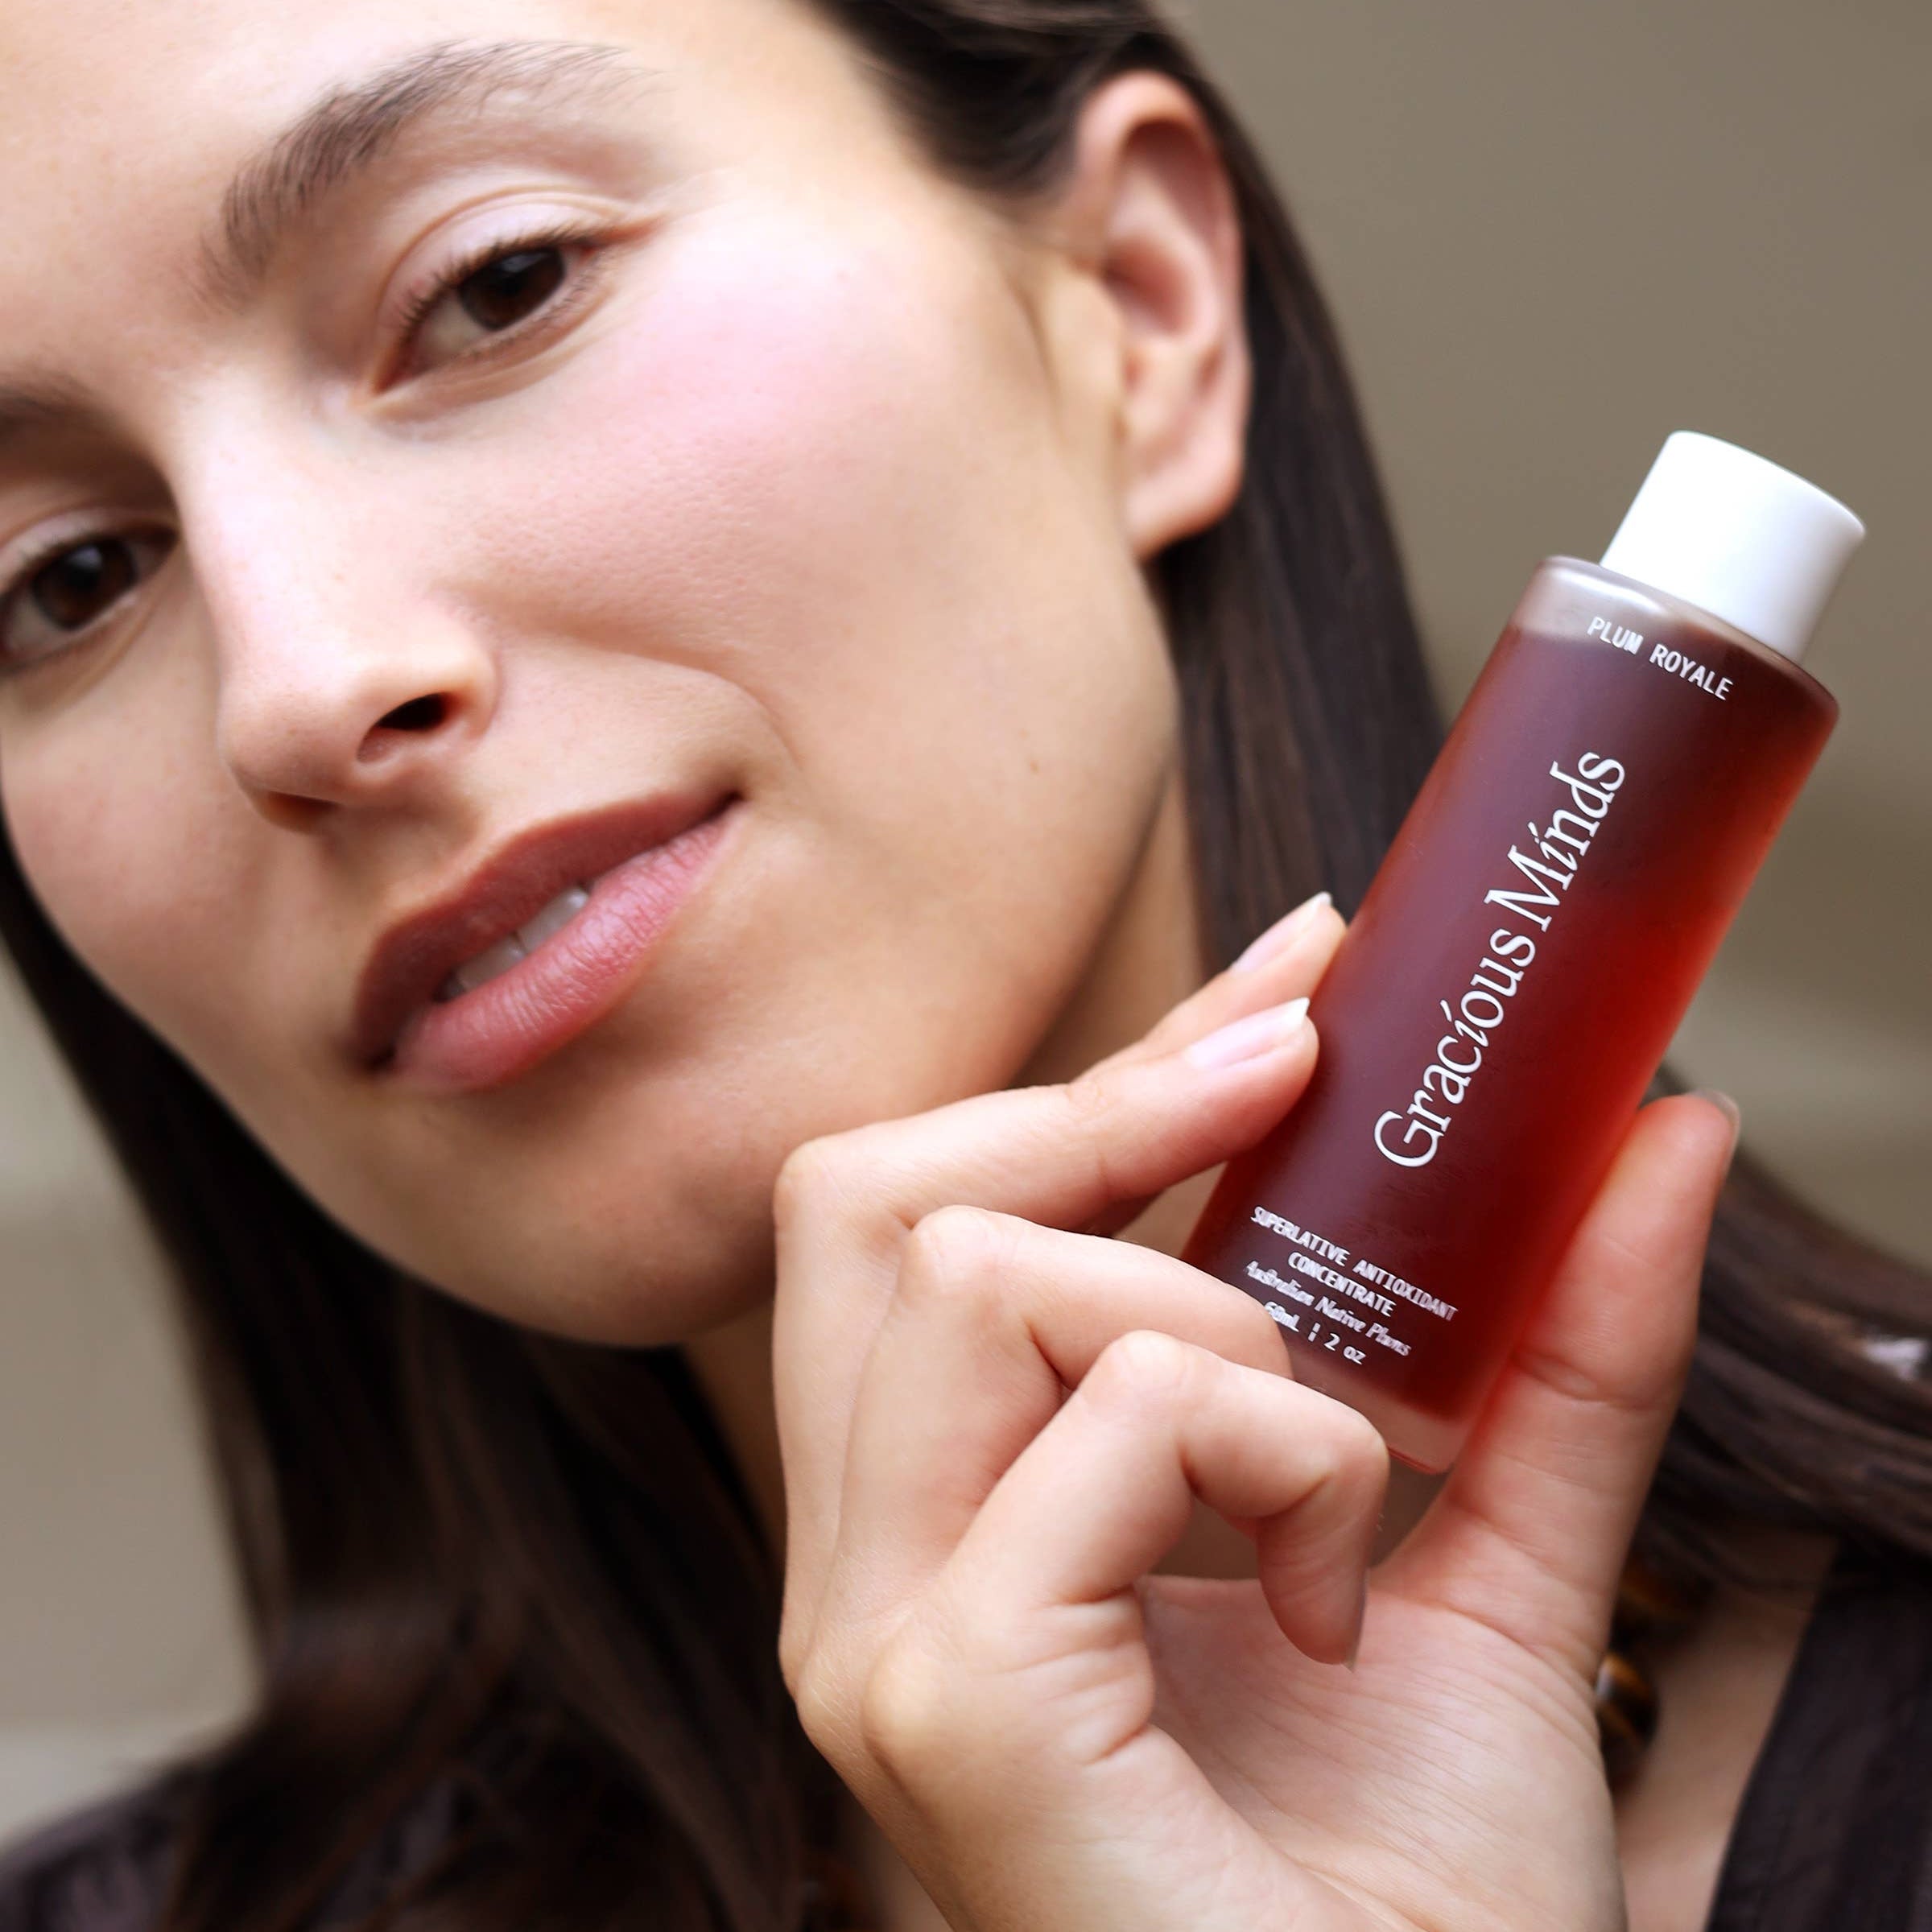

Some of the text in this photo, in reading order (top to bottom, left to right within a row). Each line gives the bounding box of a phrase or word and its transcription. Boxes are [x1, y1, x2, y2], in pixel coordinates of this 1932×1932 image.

[1587, 616, 1733, 700] PLUM ROYALE
[1251, 1206, 1458, 1321] SUPERLATIVE ANTIOXIDANT
[1288, 1252, 1397, 1317] CONCENTRATE
[1314, 1296, 1367, 1333] Native
[1323, 1332, 1340, 1352] 2
[1343, 1345, 1367, 1365] oz
